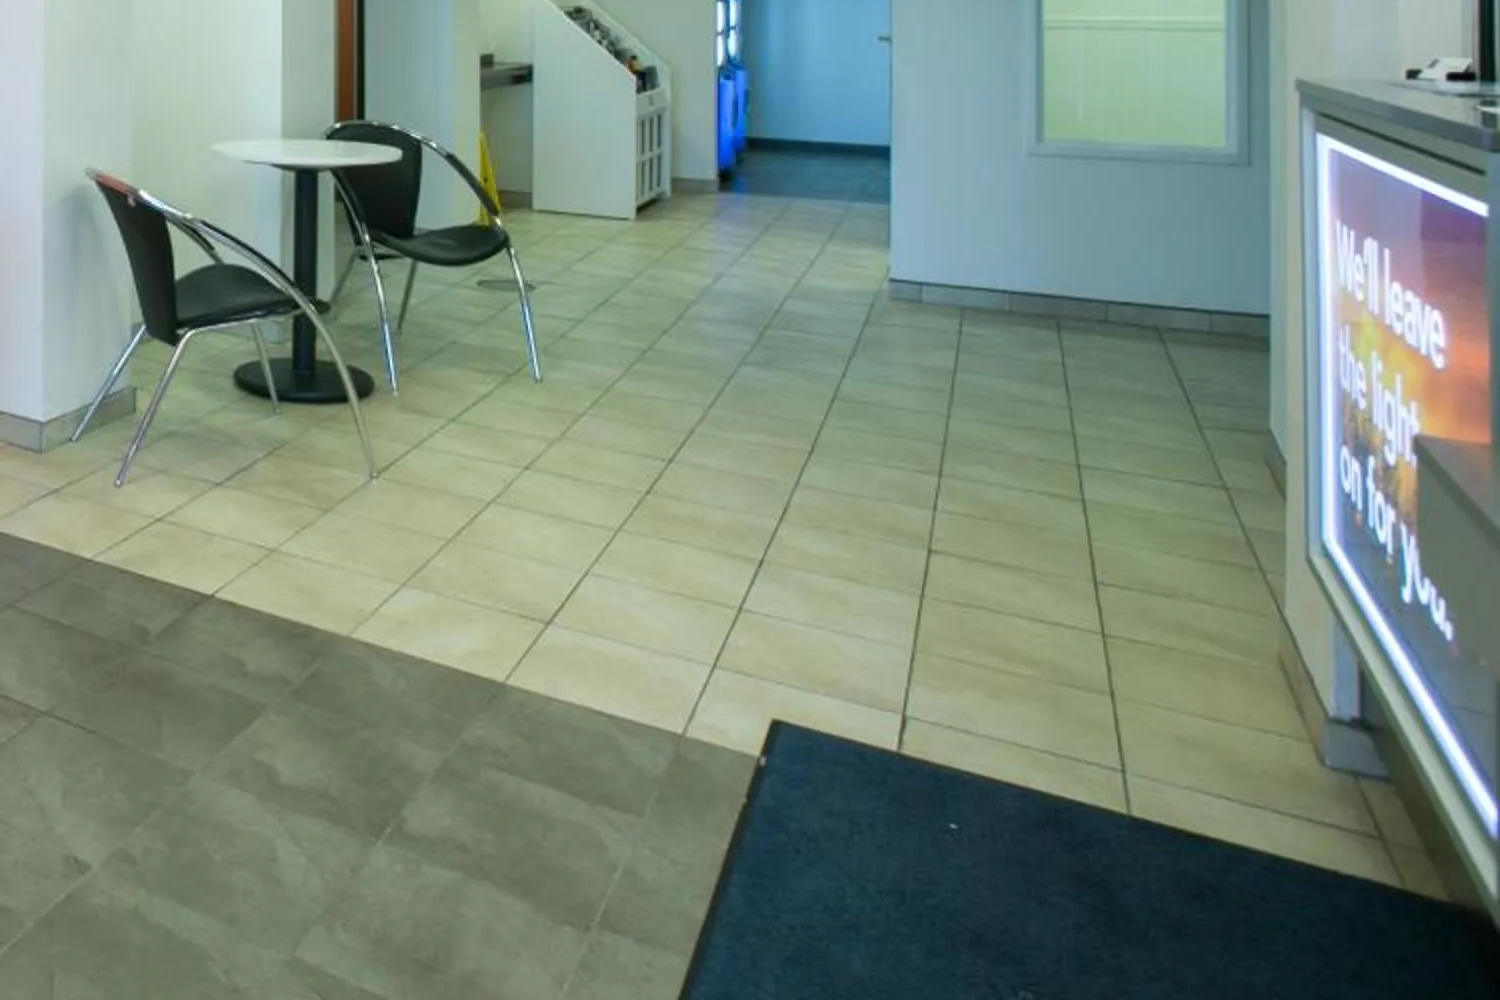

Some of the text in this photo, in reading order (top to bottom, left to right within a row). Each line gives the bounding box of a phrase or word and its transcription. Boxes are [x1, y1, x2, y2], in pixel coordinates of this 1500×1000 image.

[1336, 219, 1446, 370] We'll leave
[1339, 323, 1367, 410] the
[1340, 444, 1363, 511] on
[1366, 455, 1396, 556] for
